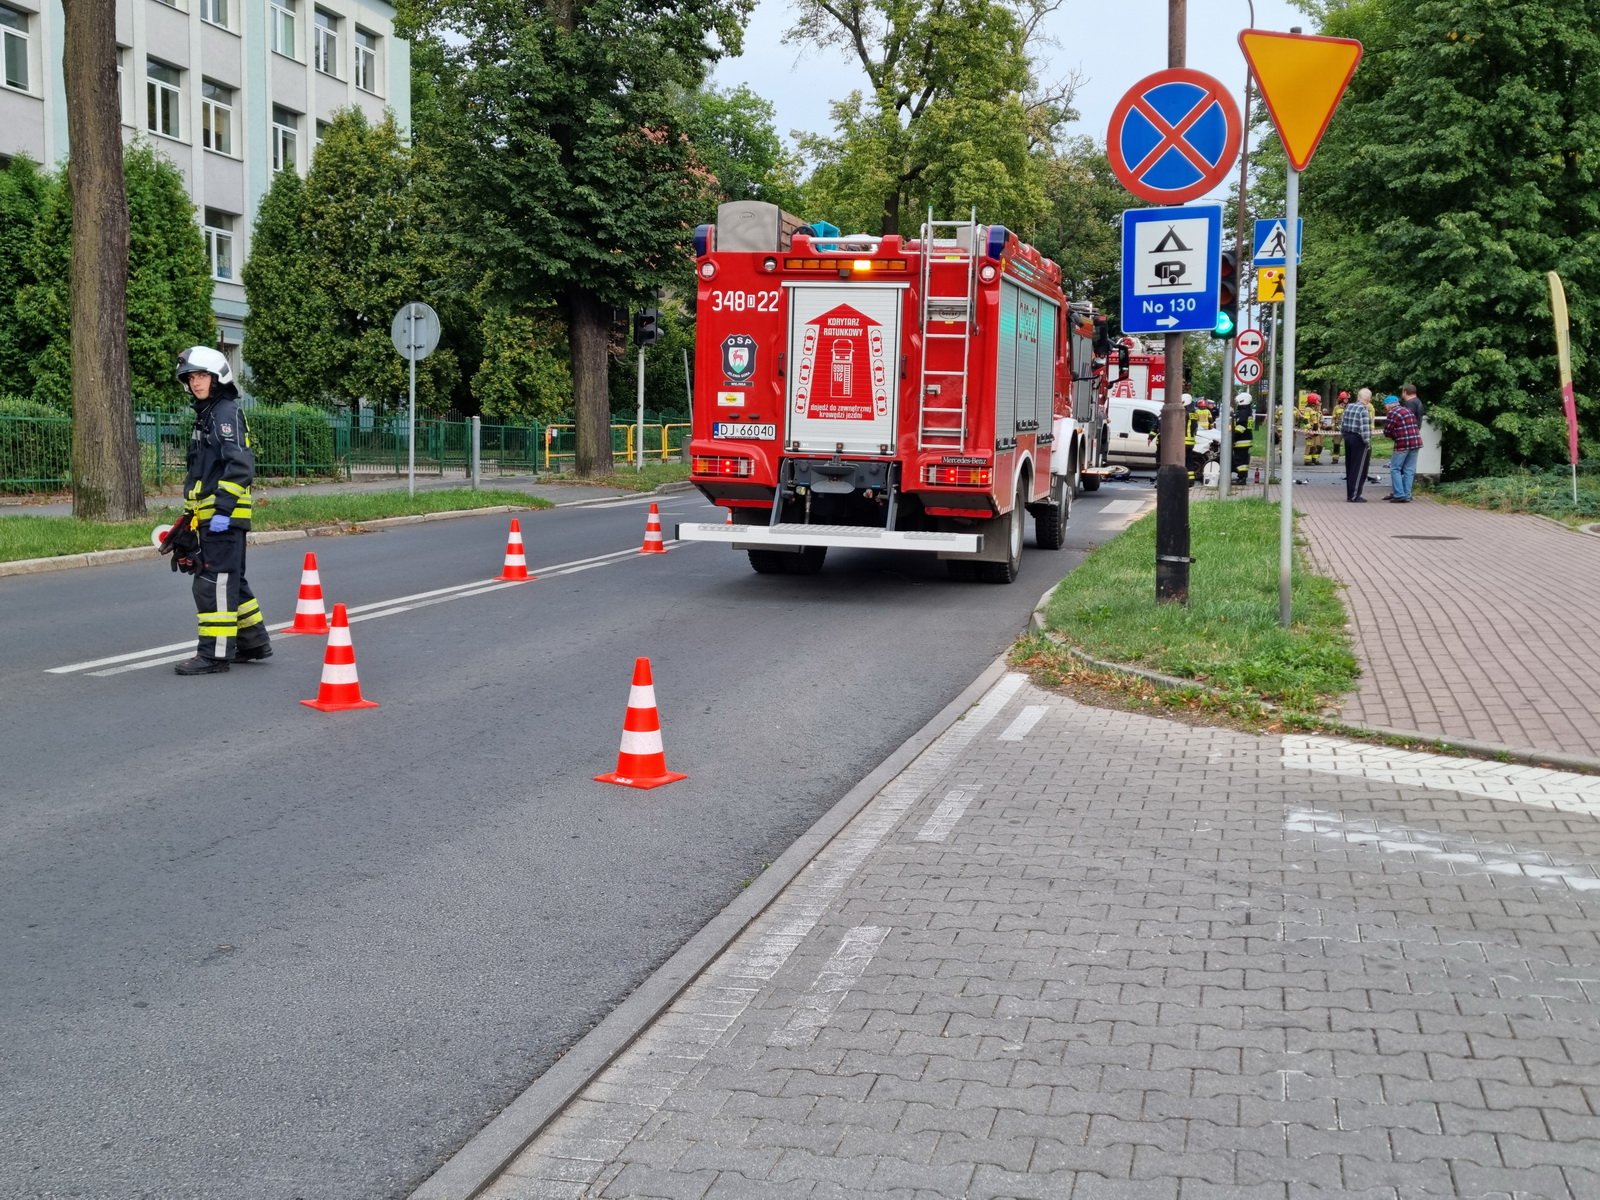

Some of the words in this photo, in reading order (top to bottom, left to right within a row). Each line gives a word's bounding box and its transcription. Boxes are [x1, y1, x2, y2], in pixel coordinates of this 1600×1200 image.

[1142, 300, 1164, 314] No
[1169, 298, 1196, 312] 130
[827, 317, 860, 326] KORYTARZ
[823, 327, 864, 337] RATUNKOWY
[727, 336, 752, 345] OSP
[1238, 363, 1259, 377] 40
[833, 372, 843, 382] 112
[829, 403, 837, 411] do
[720, 424, 735, 436] DJ
[740, 424, 774, 437] 66040
[943, 456, 987, 465] Mercedes-Benz
